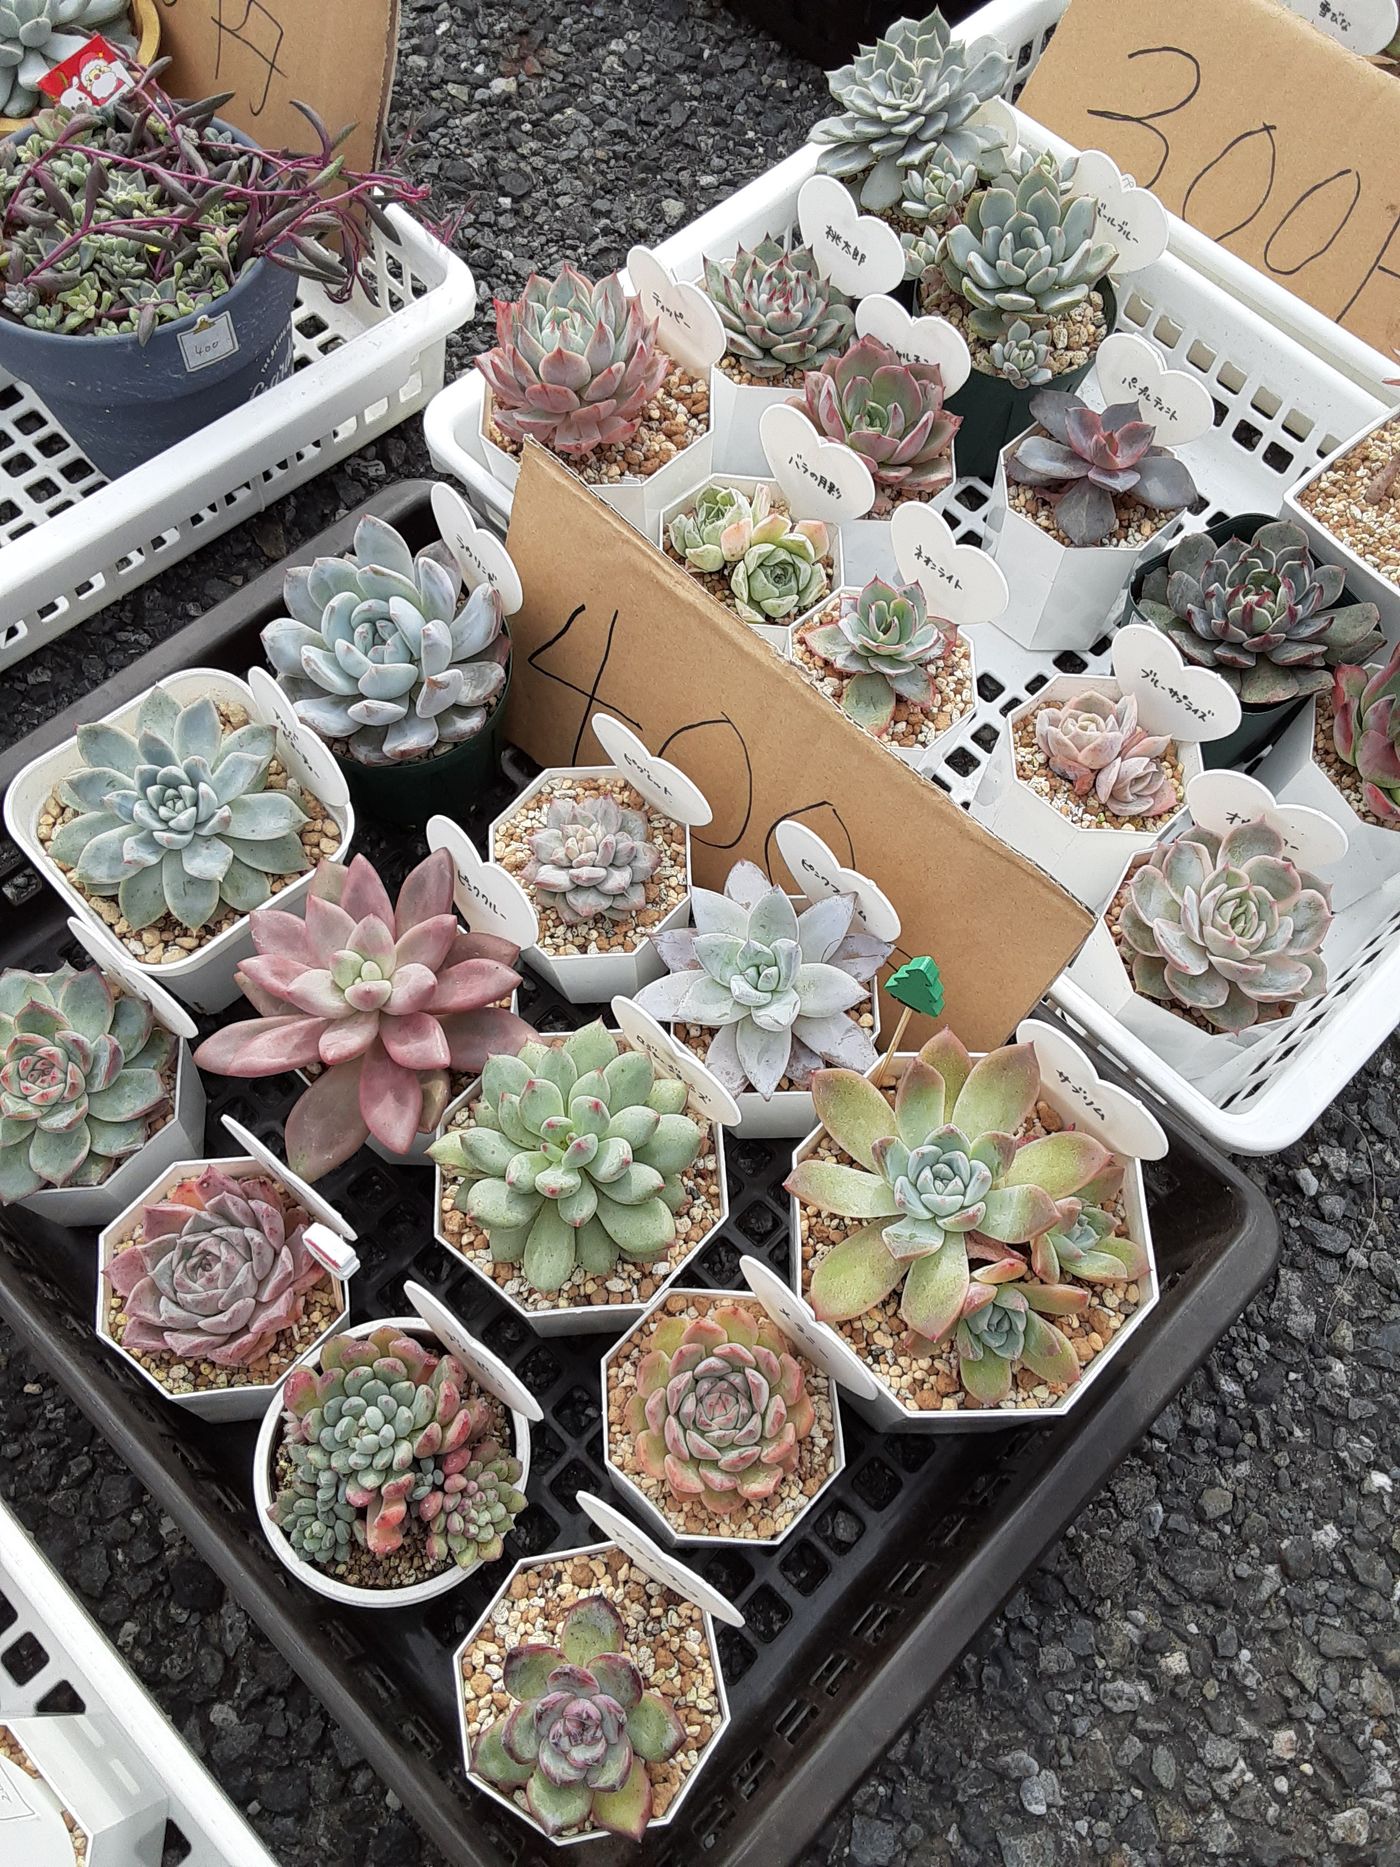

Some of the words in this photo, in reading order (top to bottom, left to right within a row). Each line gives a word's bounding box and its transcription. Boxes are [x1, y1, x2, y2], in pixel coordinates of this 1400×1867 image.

[825, 224, 867, 266] 桃太郎
[194, 340, 219, 356] 400
[1121, 376, 1179, 421] パープルティント
[787, 452, 842, 499] バラの月影
[914, 544, 963, 590] ネオンライト
[1140, 667, 1215, 722] ブルーサプライズ
[1055, 1068, 1105, 1121] サブリム
